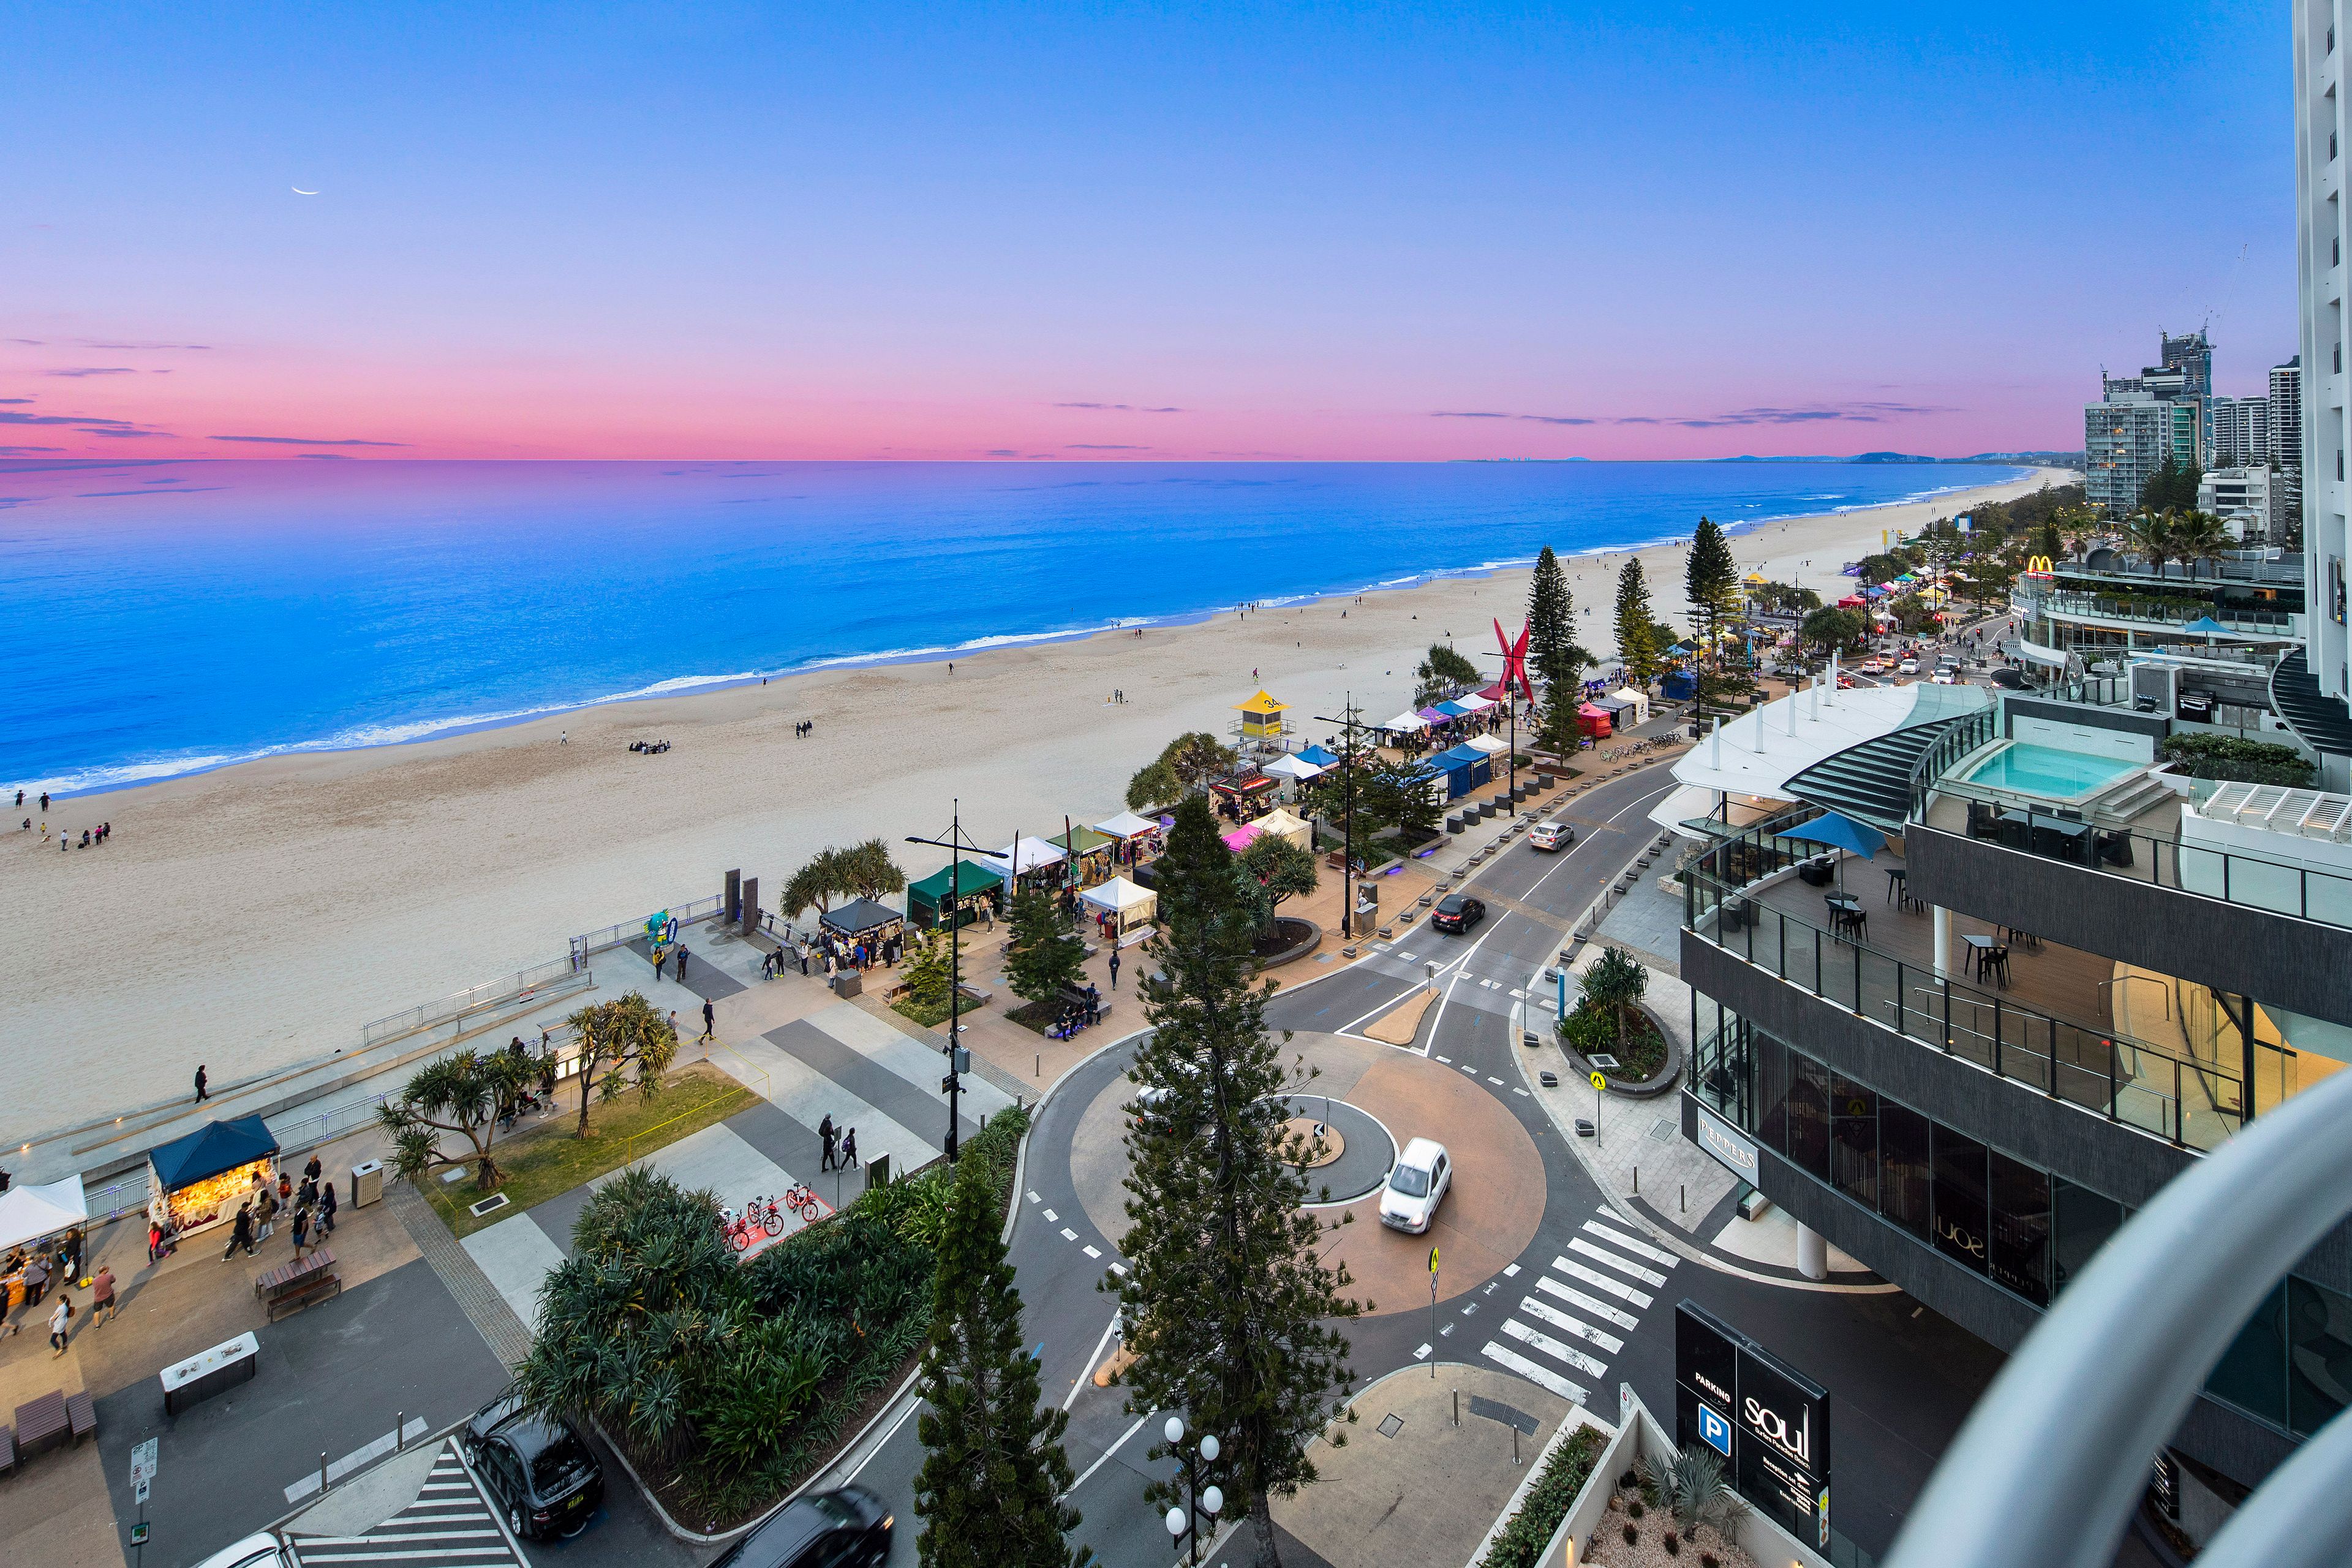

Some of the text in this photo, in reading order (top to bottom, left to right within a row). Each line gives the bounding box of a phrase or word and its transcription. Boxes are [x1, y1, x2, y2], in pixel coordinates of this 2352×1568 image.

[821, 917, 852, 937] Custom Image Engraving
[854, 927, 869, 937] Custom
[882, 918, 901, 929] Engraving
[1700, 1118, 1755, 1168] PEPPERS
[1696, 1372, 1730, 1403] PARKING
[1706, 1414, 1722, 1439] P
[133, 1444, 143, 1453] 2P
[1755, 1427, 1811, 1471] Surfers Paradise Beach
[1763, 1456, 1788, 1480] Reception
[1797, 1482, 1811, 1496] down
[1779, 1489, 1811, 1517] Entertainment
[1790, 1487, 1811, 1506] Shopping
[1796, 1497, 1811, 1512] Dining
